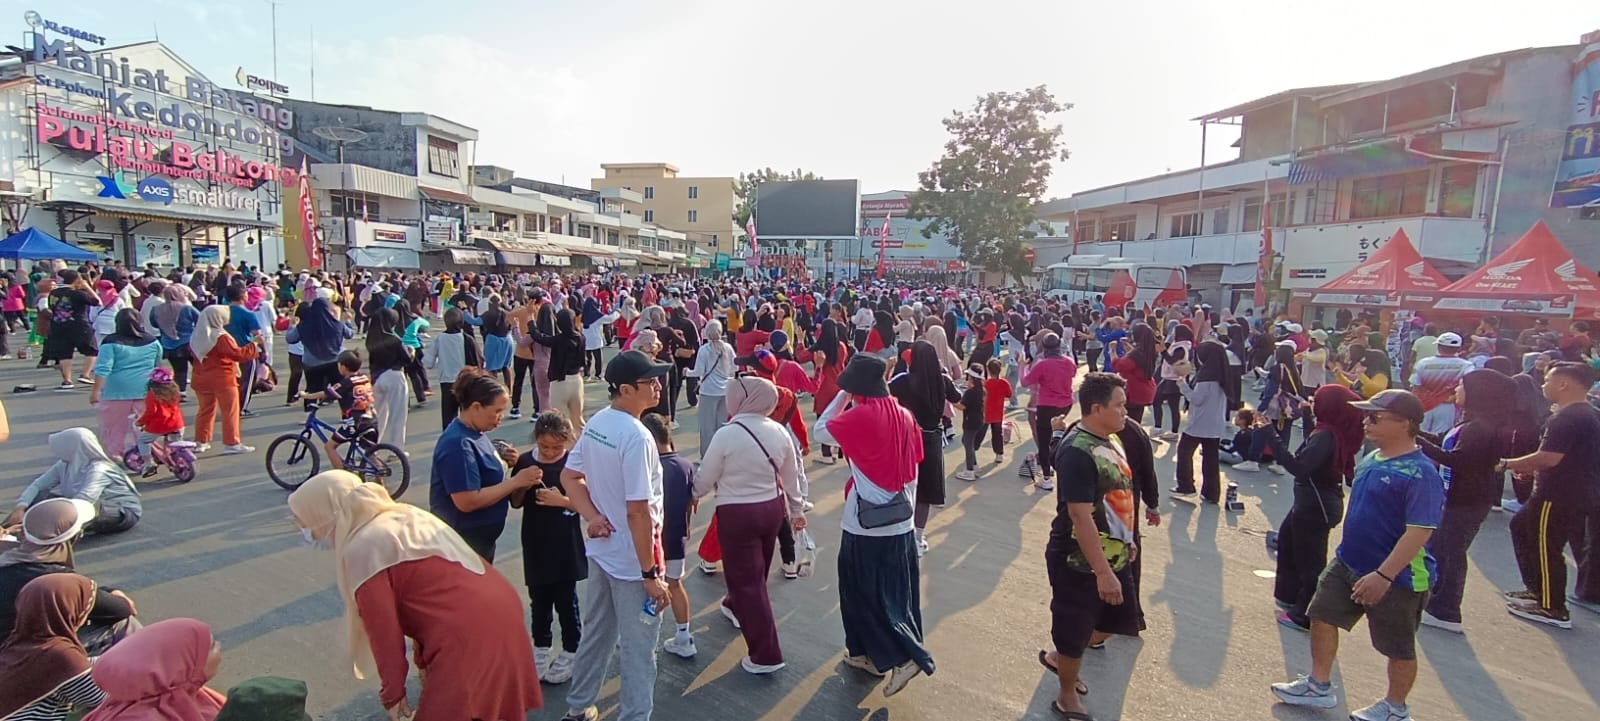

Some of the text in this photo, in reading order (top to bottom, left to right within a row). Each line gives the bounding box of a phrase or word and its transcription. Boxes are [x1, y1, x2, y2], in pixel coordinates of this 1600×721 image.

[45, 20, 106, 46] XLSMART
[34, 33, 293, 130] Manjat Batang
[55, 78, 105, 99] Pohon
[37, 103, 174, 139] Selamat Datang di
[108, 87, 295, 157] Kedondong
[37, 113, 297, 188] Pulau Belitong
[111, 156, 255, 188] Nikmati Internet Tercepat
[142, 185, 170, 197] AXIS
[860, 227, 893, 236] BABL
